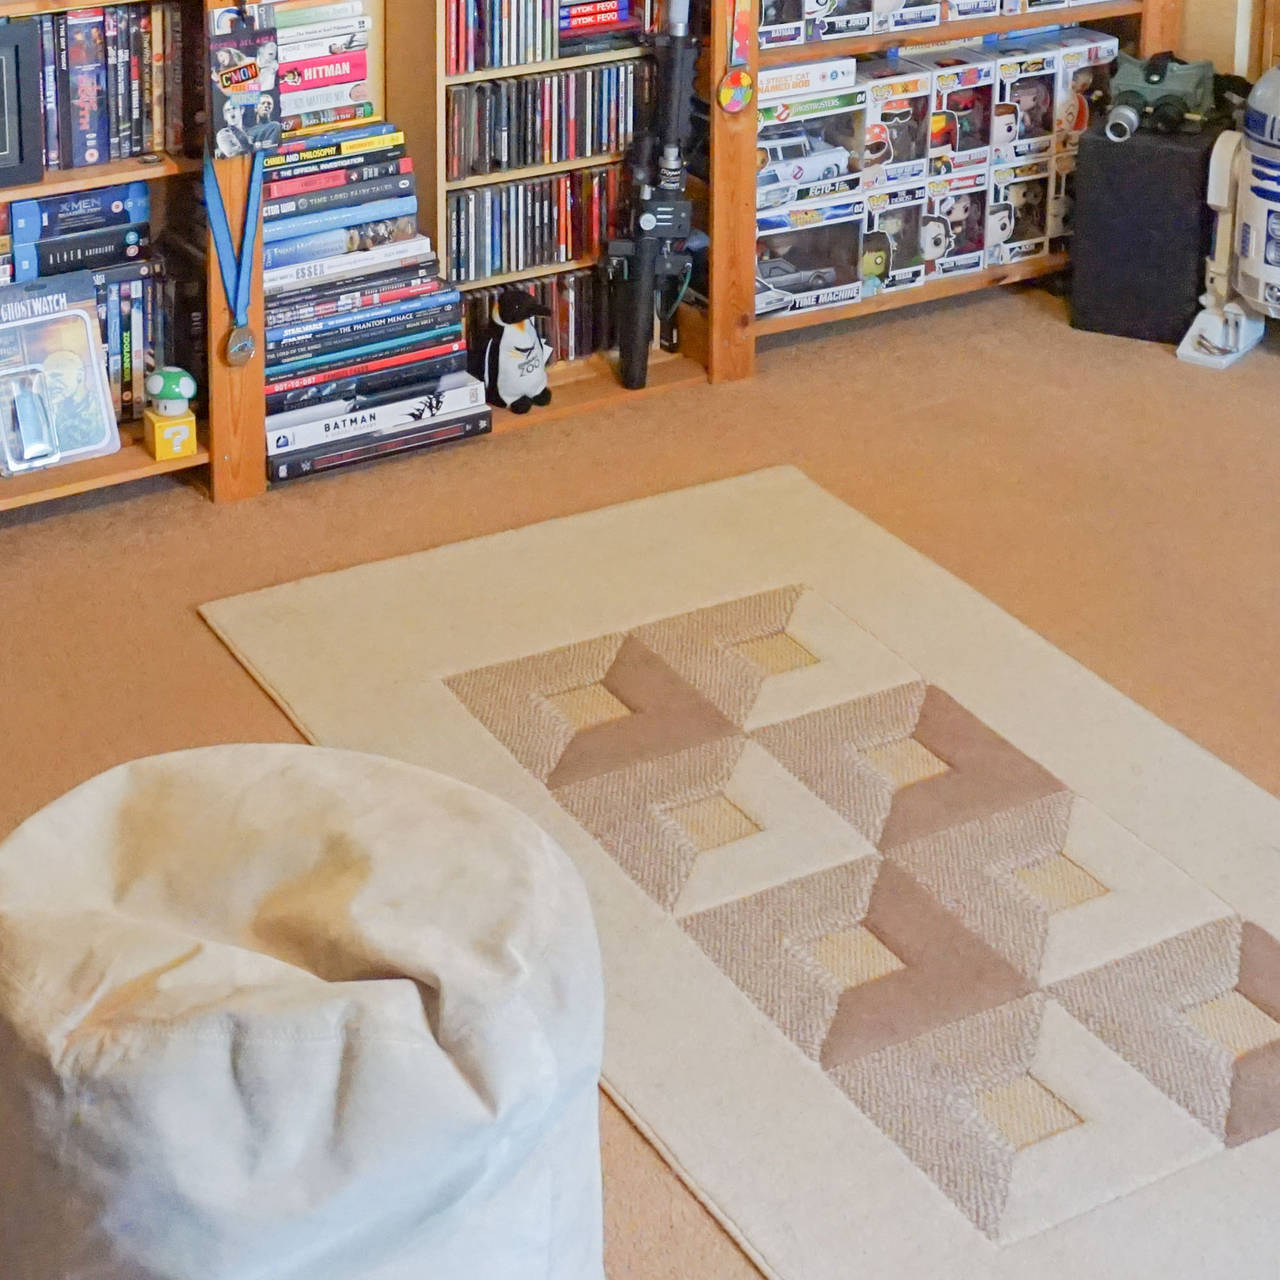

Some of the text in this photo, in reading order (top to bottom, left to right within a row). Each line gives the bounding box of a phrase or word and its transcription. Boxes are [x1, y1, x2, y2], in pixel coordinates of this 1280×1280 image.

[835, 18, 847, 29] THE
[221, 64, 258, 87] C'MON
[303, 62, 351, 81] HITMAN
[793, 72, 811, 81] CAT
[791, 78, 811, 89] BOB
[791, 98, 840, 113] GHOSTBUSTERS
[856, 91, 866, 103] 04
[300, 146, 337, 161] PHILOSOPHY
[280, 169, 293, 178] THE
[320, 157, 365, 171] INVESTIGATION
[809, 181, 840, 197] ECTO-1
[310, 197, 328, 206] TIME
[329, 192, 349, 202] LORD
[795, 287, 860, 308] TIME MACHINE
[0, 293, 69, 322] GHOSTWATCH
[339, 324, 353, 335] THE
[353, 318, 386, 331] PHANTOM
[386, 313, 414, 325] MENACE
[122, 330, 131, 382] ZOOLANDER
[519, 358, 540, 378] ZOO
[323, 412, 377, 434] BATMAN
